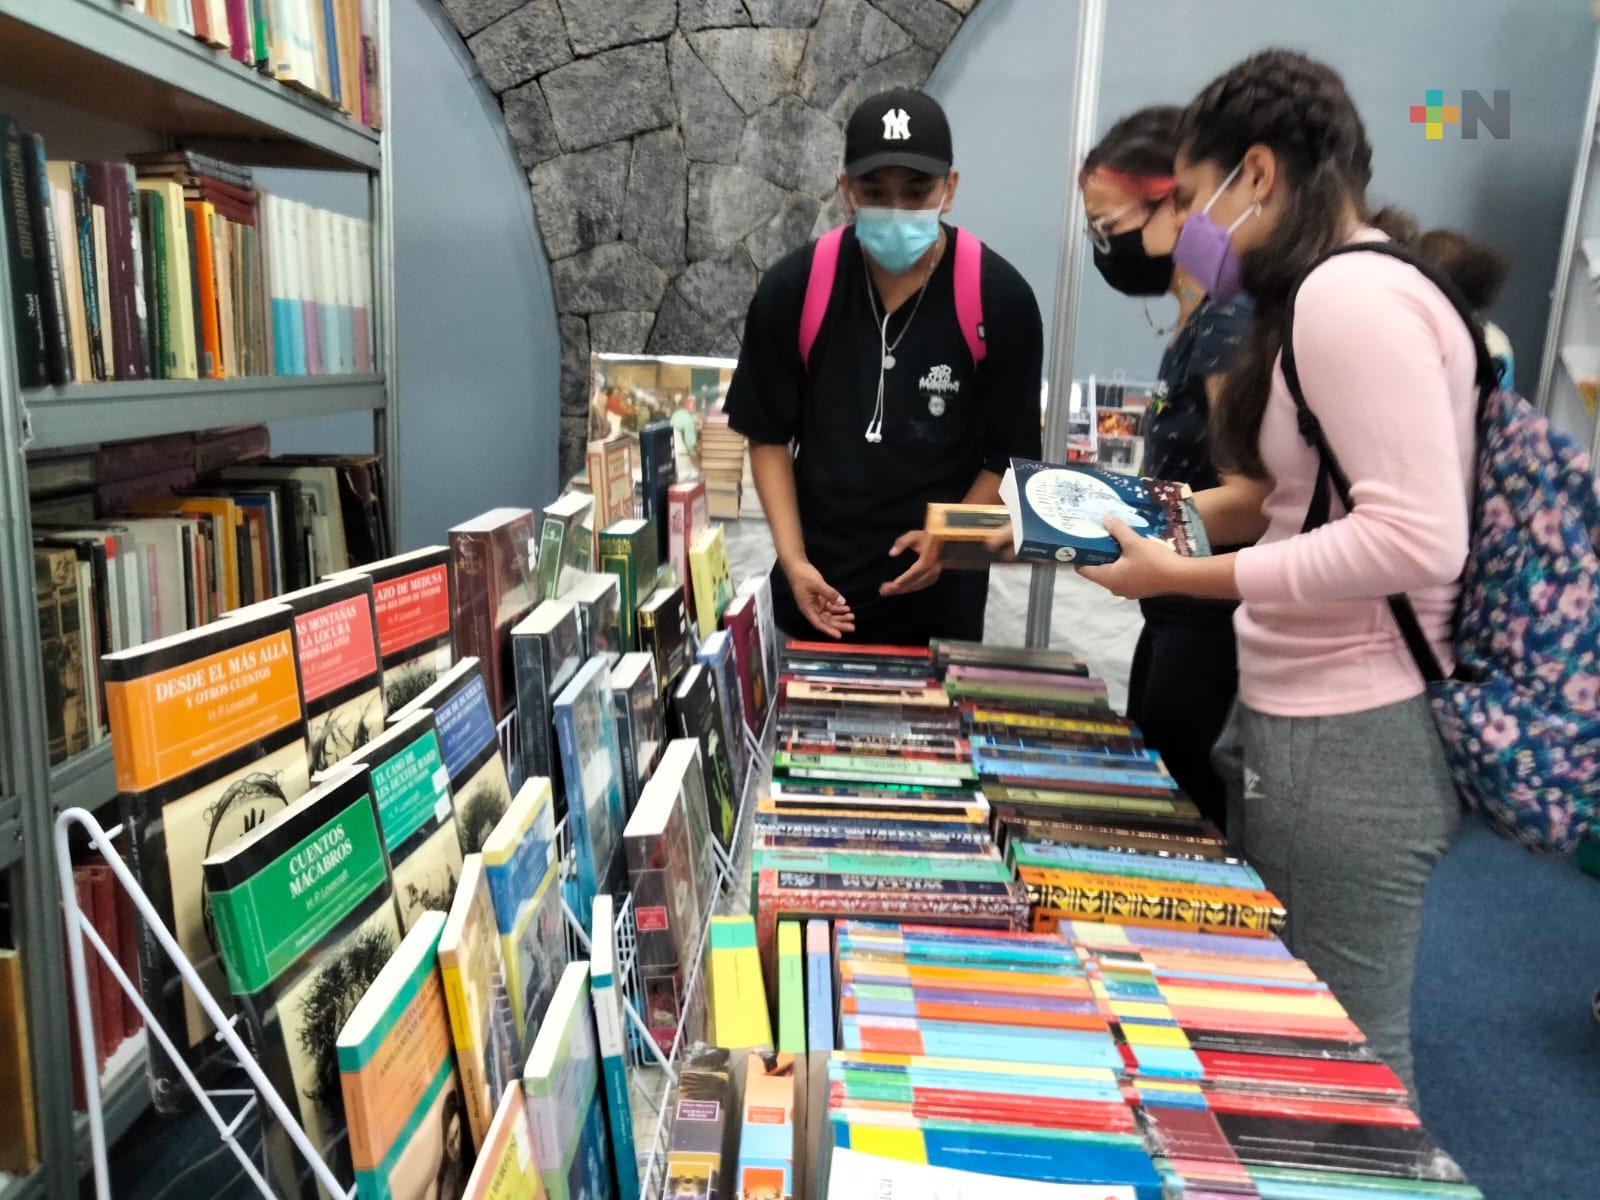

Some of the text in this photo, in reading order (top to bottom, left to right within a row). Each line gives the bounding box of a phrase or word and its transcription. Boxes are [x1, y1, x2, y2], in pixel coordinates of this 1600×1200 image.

[375, 571, 442, 601] AZO DE MEDUSA
[300, 620, 351, 649] LA LOCURA
[308, 604, 357, 630] MONTAÑAS
[155, 638, 289, 704] DESDE EL MÁS ALLÁ
[195, 682, 229, 704] OTROS
[229, 666, 272, 691] CUENTOS
[289, 823, 345, 875] CUENTOS
[289, 837, 353, 899] MACABROS
